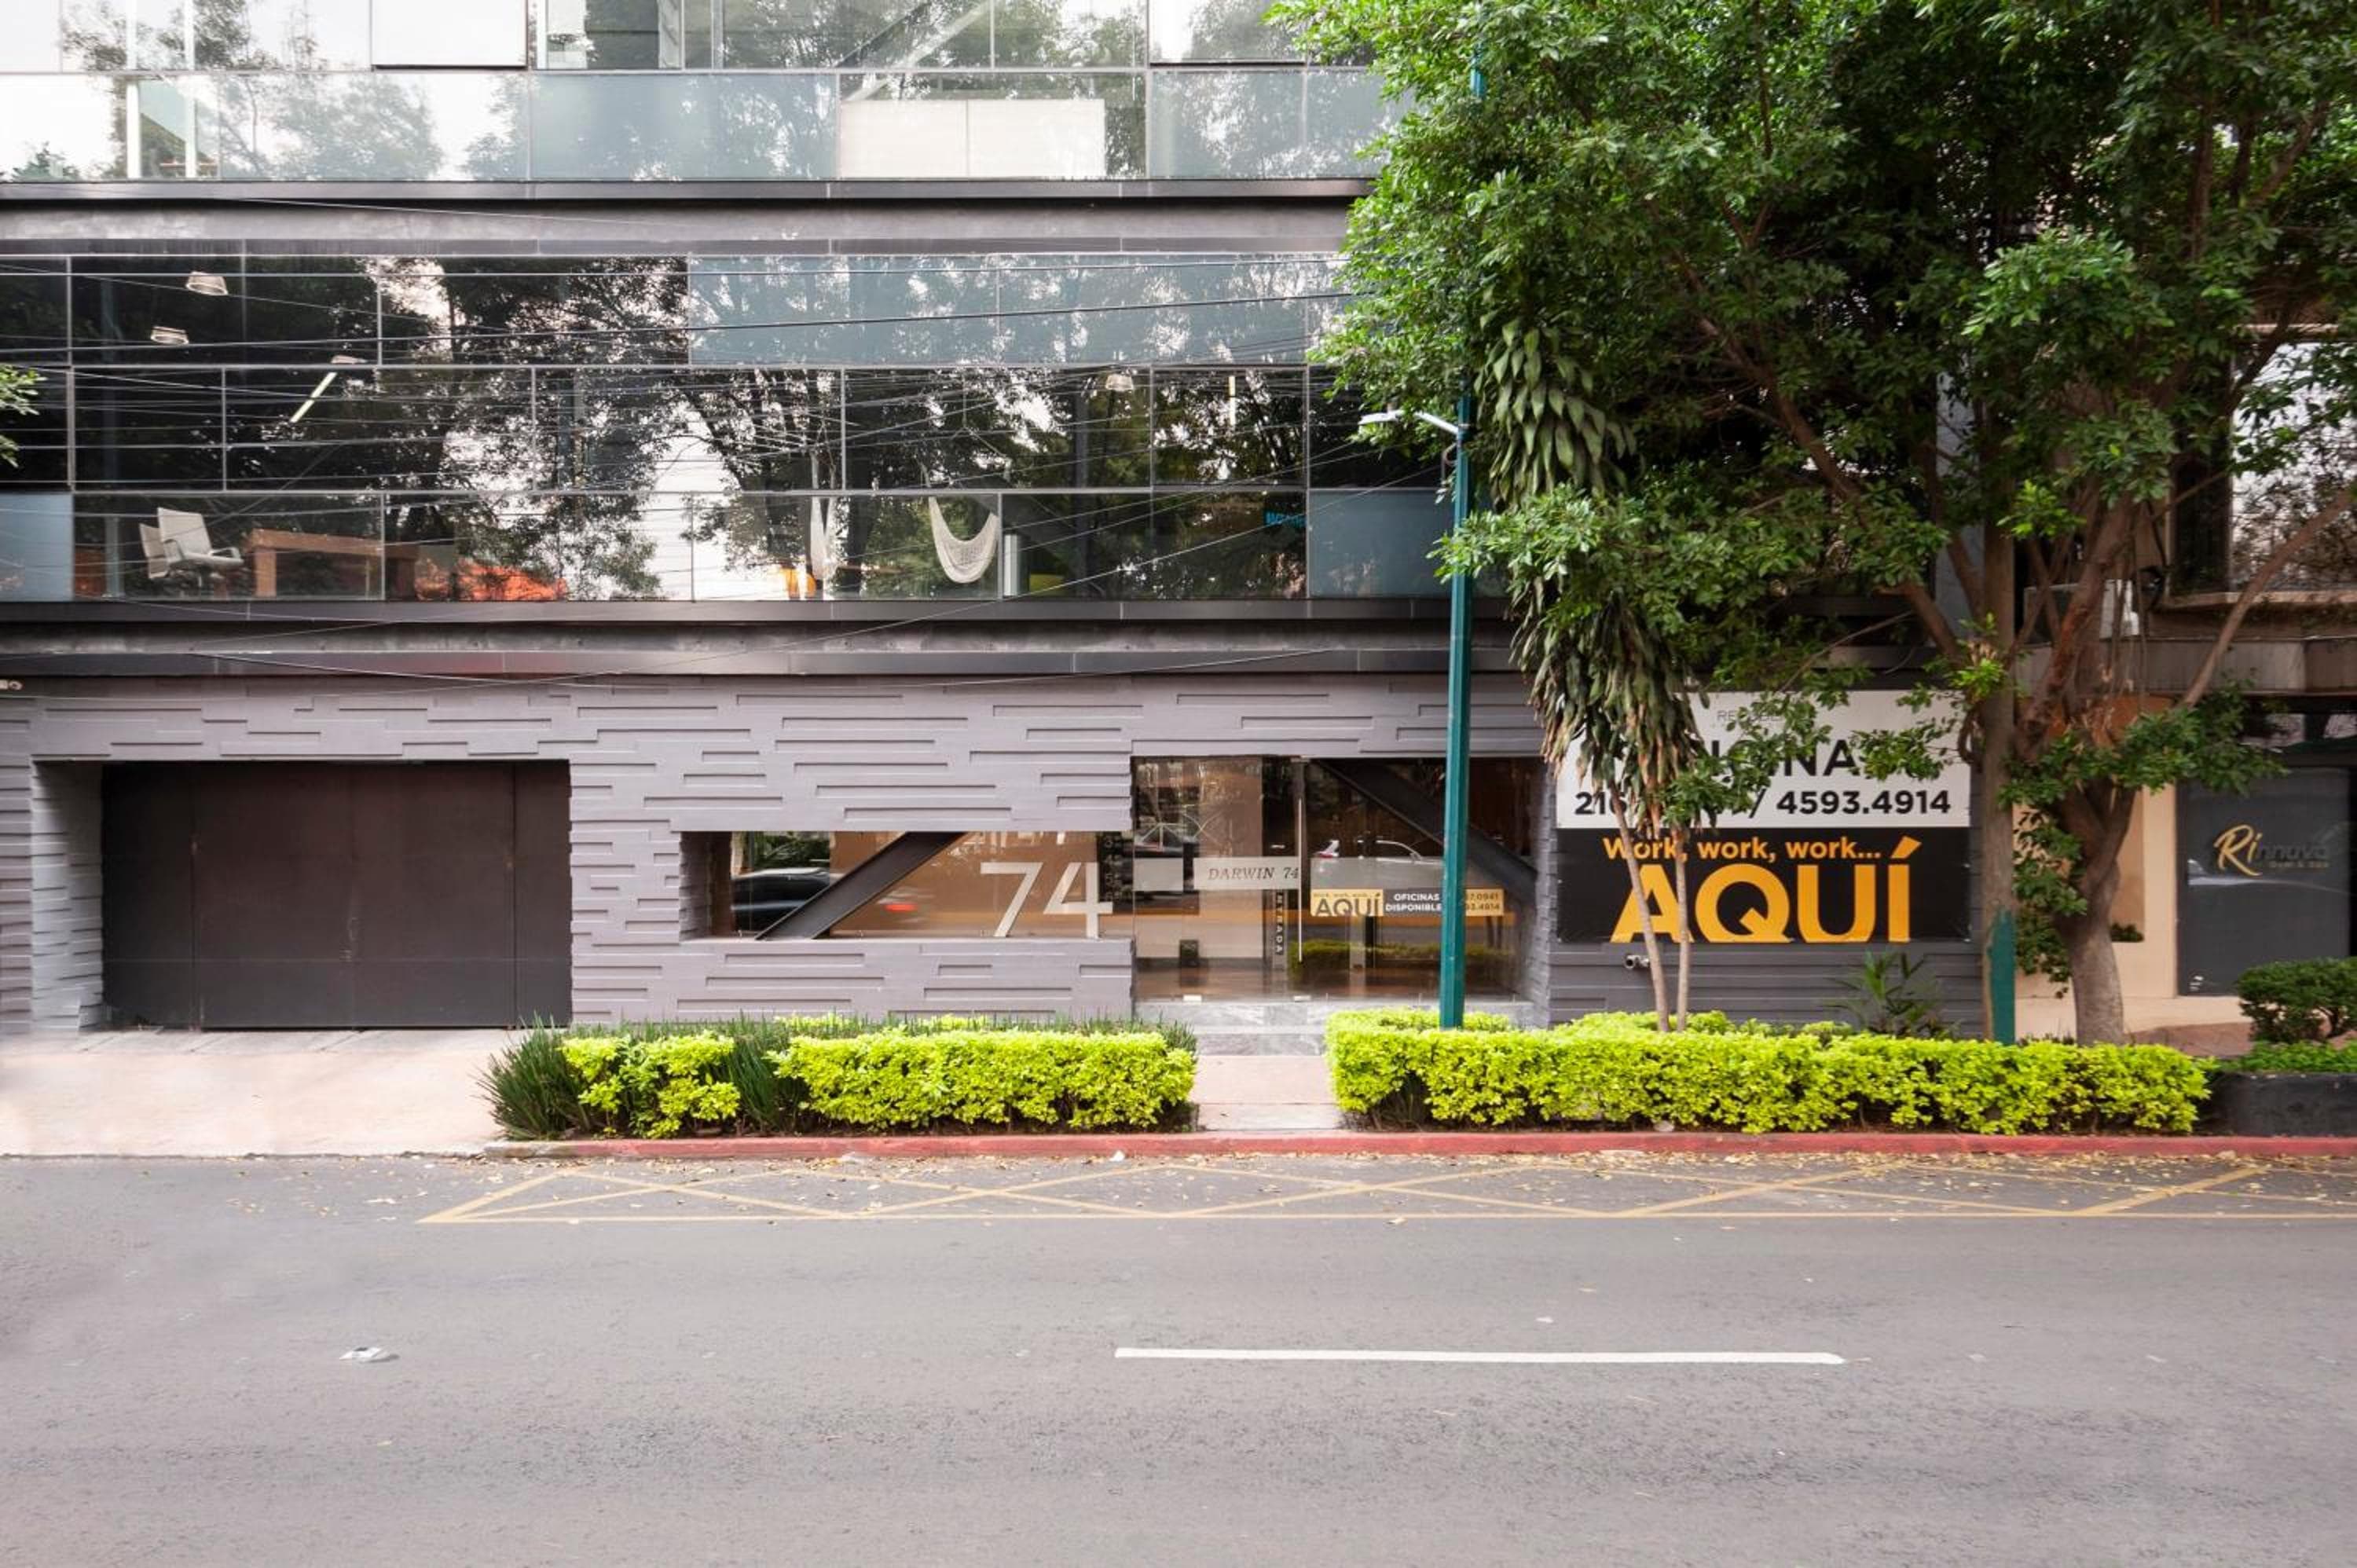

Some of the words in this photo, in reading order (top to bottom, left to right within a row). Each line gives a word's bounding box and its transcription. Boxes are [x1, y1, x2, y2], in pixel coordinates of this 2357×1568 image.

[1776, 789, 1951, 815] 4593.4914
[1603, 837, 1688, 863] Work,
[1697, 837, 1776, 863] work,
[1786, 837, 1881, 859] work...
[1208, 867, 1275, 881] DARWIN
[981, 863, 1113, 940] 74
[1610, 836, 1922, 943] AQUÍ
[1315, 892, 1380, 917] AQUÍ
[1385, 903, 1442, 912] DISPONIBLE
